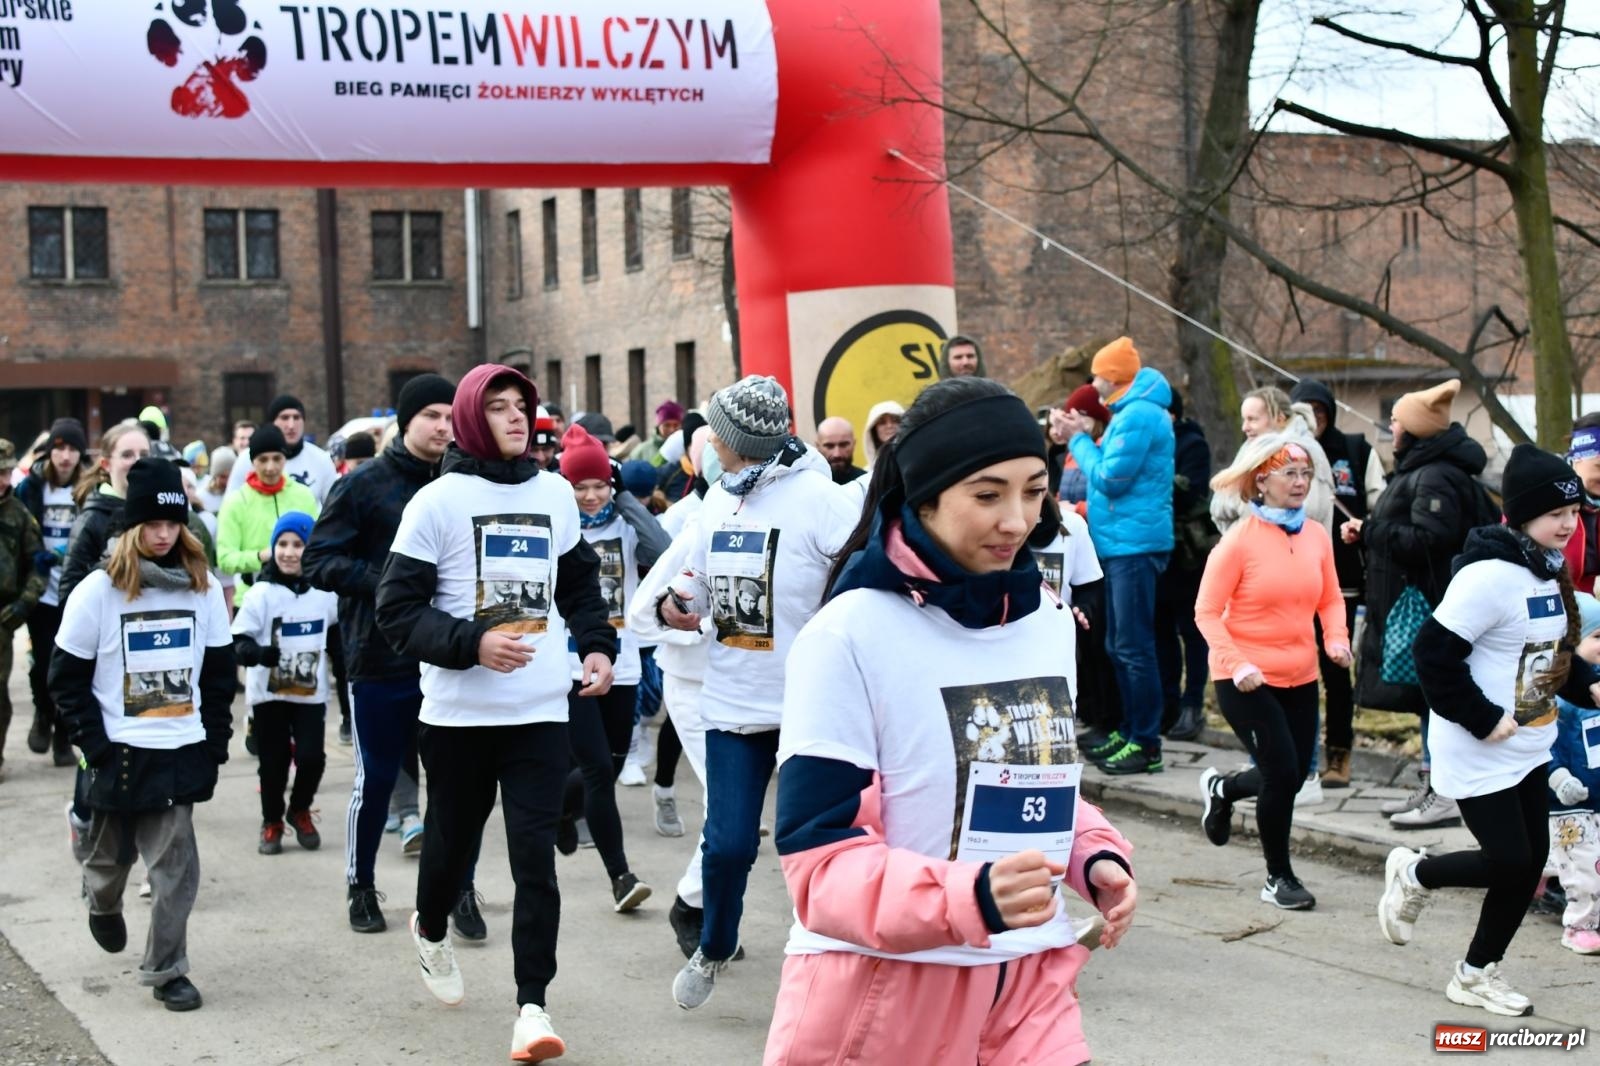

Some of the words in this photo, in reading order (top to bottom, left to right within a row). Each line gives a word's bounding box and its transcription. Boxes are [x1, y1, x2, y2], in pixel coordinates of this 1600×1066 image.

[335, 81, 383, 96] BIEG
[391, 82, 470, 102] PAMIĘCI
[477, 81, 585, 100] ŻOŁNIERZY
[592, 88, 704, 103] WYKLĘTYCH
[511, 539, 528, 553] 24
[728, 534, 744, 549] 20
[153, 632, 171, 646] 26
[1021, 796, 1047, 822] 53
